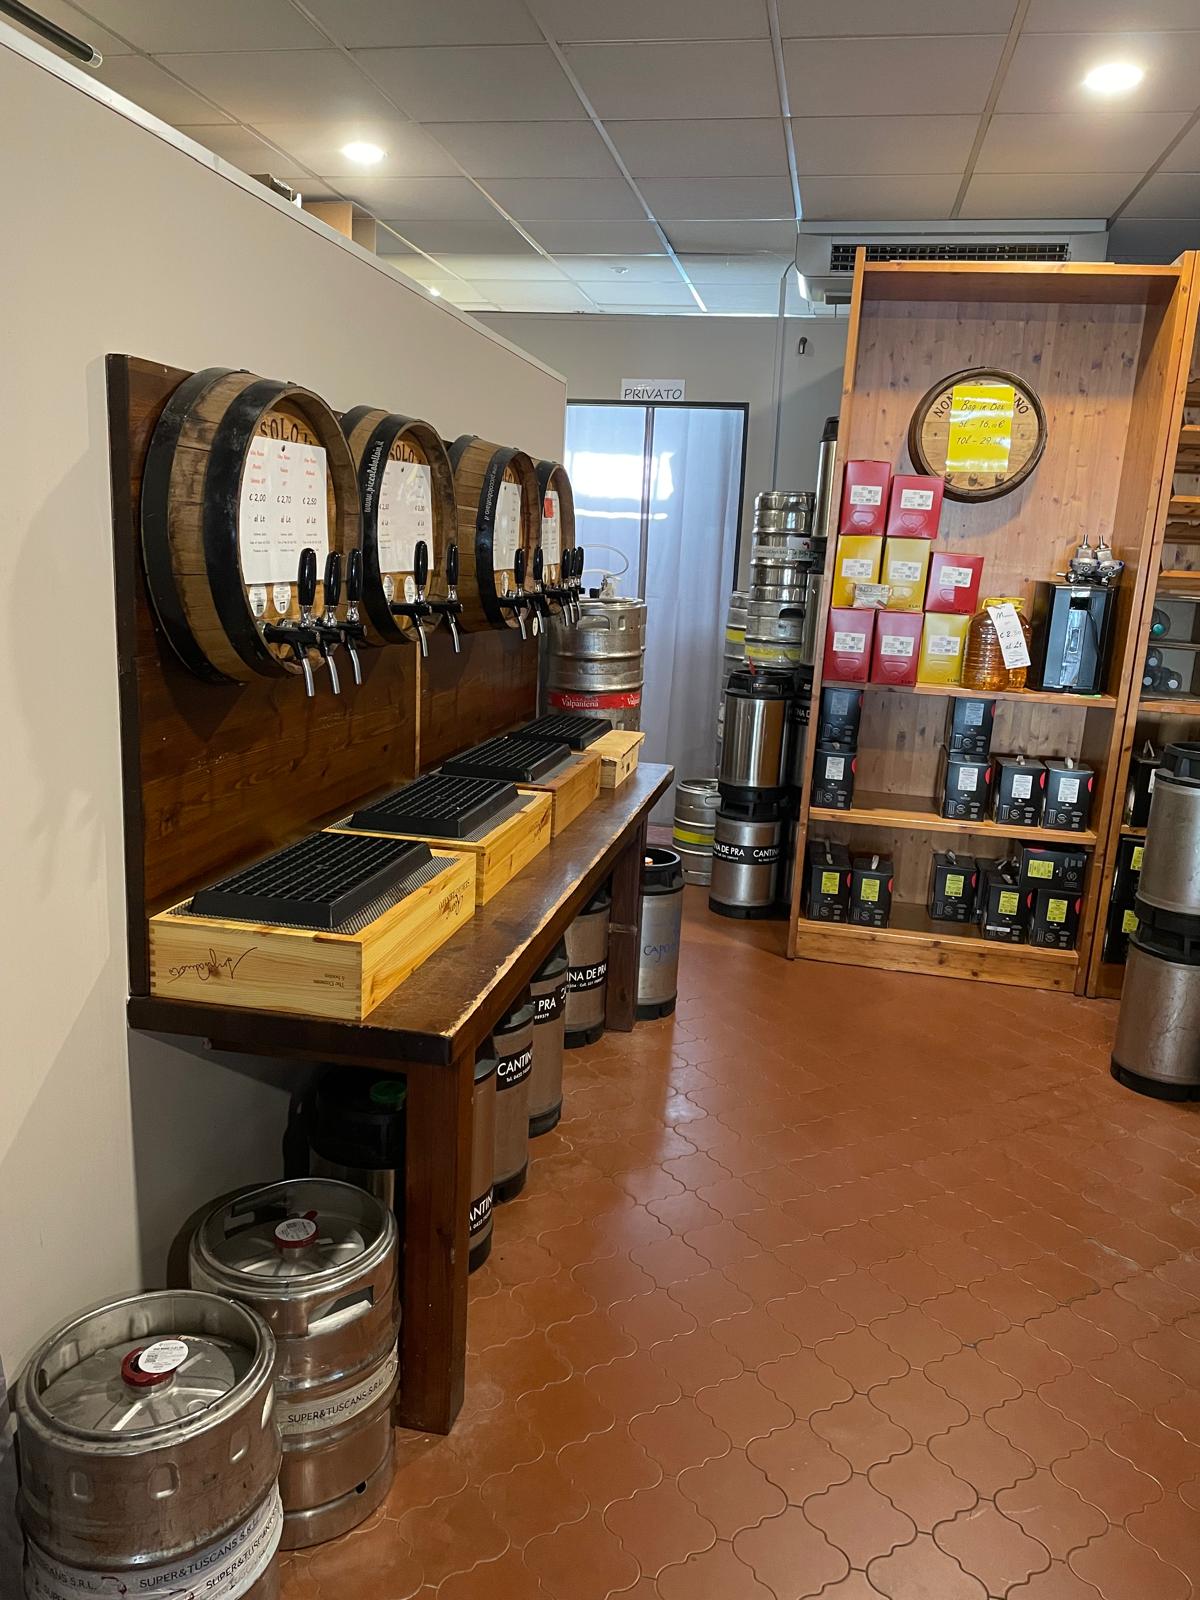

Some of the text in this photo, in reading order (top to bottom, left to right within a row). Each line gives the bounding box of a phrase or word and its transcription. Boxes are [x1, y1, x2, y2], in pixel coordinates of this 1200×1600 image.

[624, 388, 682, 399] PRIVATO
[260, 417, 299, 443] SOLO
[731, 847, 745, 857] PRA
[586, 968, 597, 980] DE
[538, 997, 556, 1012] PRA
[288, 1391, 367, 1423] SUPER&TUSCANS
[140, 1538, 238, 1588] SUPER&TUSCANS
